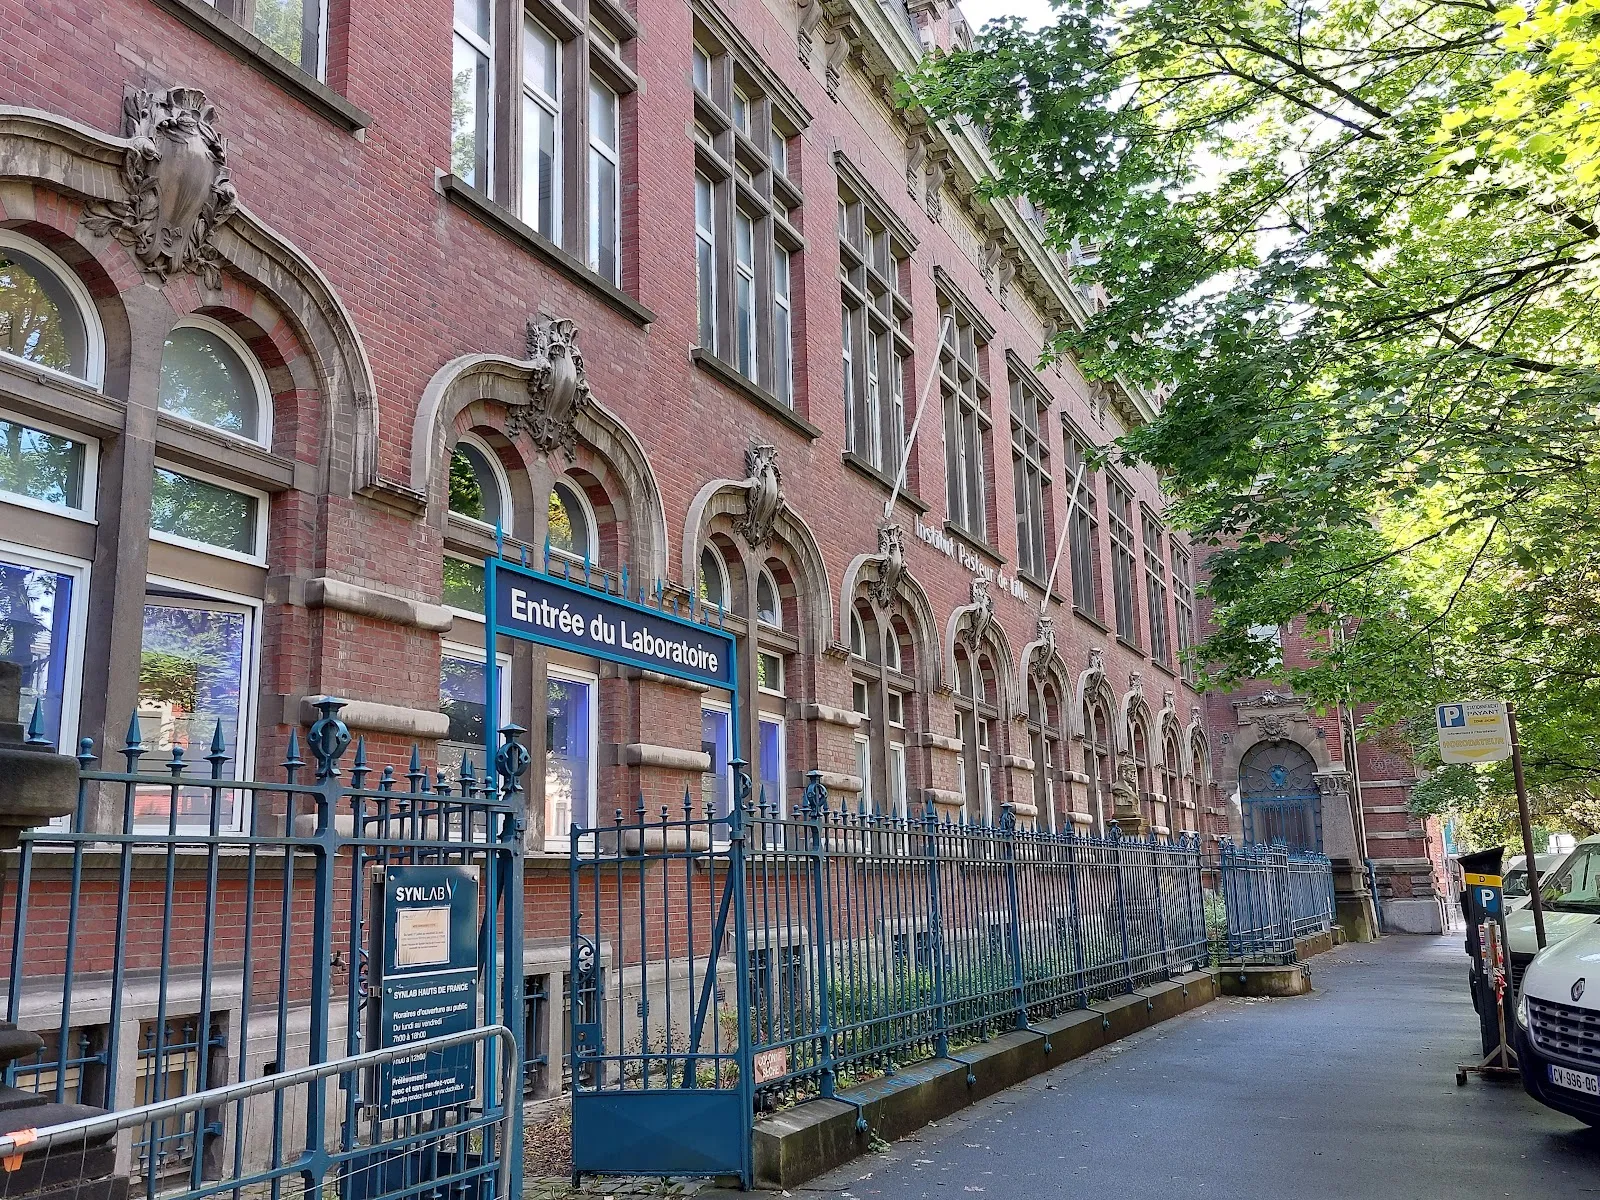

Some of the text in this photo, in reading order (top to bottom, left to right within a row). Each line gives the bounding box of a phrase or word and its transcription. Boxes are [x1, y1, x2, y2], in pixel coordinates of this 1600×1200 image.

[915, 514, 955, 560] Institut
[959, 542, 994, 582] Pasteur
[511, 588, 719, 673] Entrée du Laboratoire
[1444, 706, 1460, 726] P
[1442, 737, 1505, 749] HORODATEUR
[395, 886, 445, 902] SYNLAB
[1481, 889, 1495, 908] P
[393, 982, 469, 1000] SYNLAB HAUTS DE FRANCE
[393, 1010, 416, 1020] Horaires
[416, 1006, 446, 1017] d'ouverture
[453, 1002, 468, 1013] public
[392, 1024, 401, 1032] Du
[401, 1022, 414, 1031] lundi
[421, 1017, 443, 1027] vendredi
[392, 1034, 406, 1043] 7h00
[411, 1030, 427, 1040] 18h00
[391, 1073, 428, 1086] Prélèvements
[391, 1077, 456, 1097] avec et sans rendez-vous
[1553, 1068, 1597, 1092] CV-996-QG
[390, 1095, 407, 1105] Prendre
[407, 1091, 433, 1102] rendez-vous
